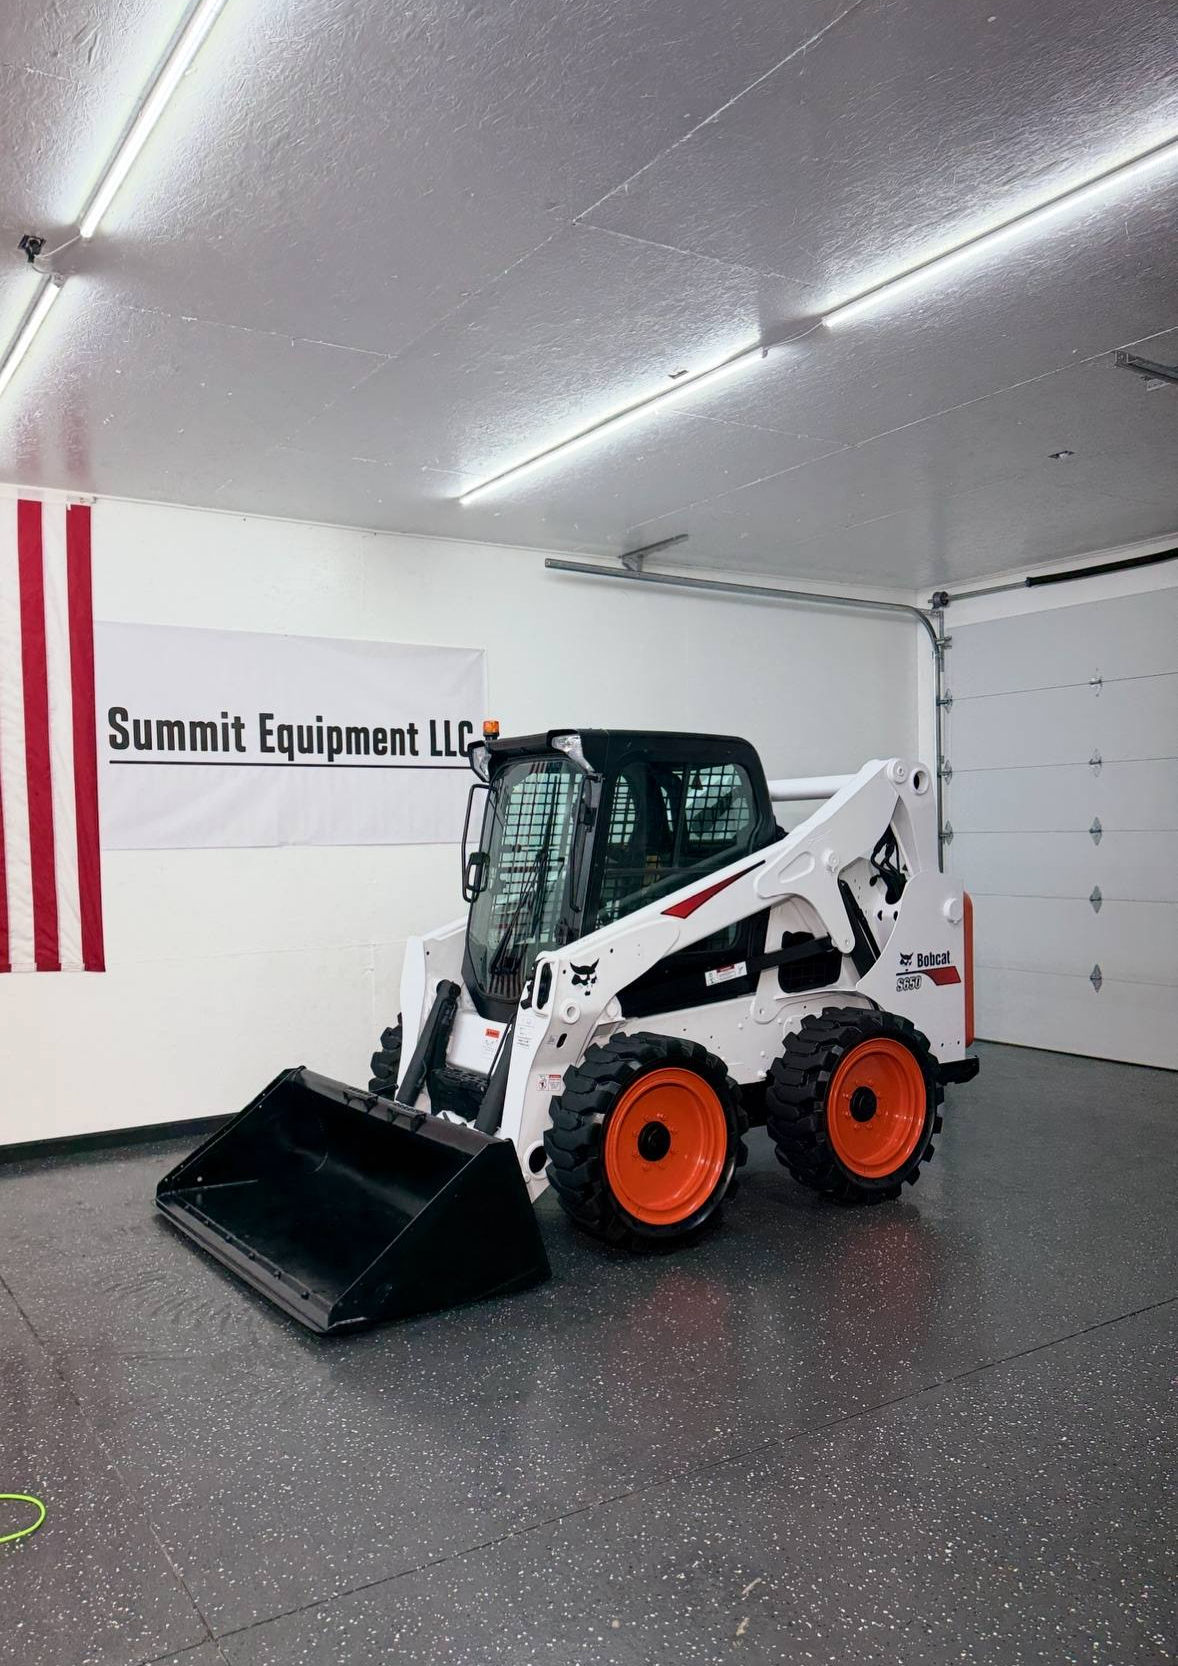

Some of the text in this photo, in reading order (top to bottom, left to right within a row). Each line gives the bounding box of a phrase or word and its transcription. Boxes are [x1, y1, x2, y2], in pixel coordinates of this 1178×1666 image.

[108, 707, 473, 762] Summit Equipment LLC
[917, 950, 950, 967] Bobcat
[896, 975, 922, 992] S650
